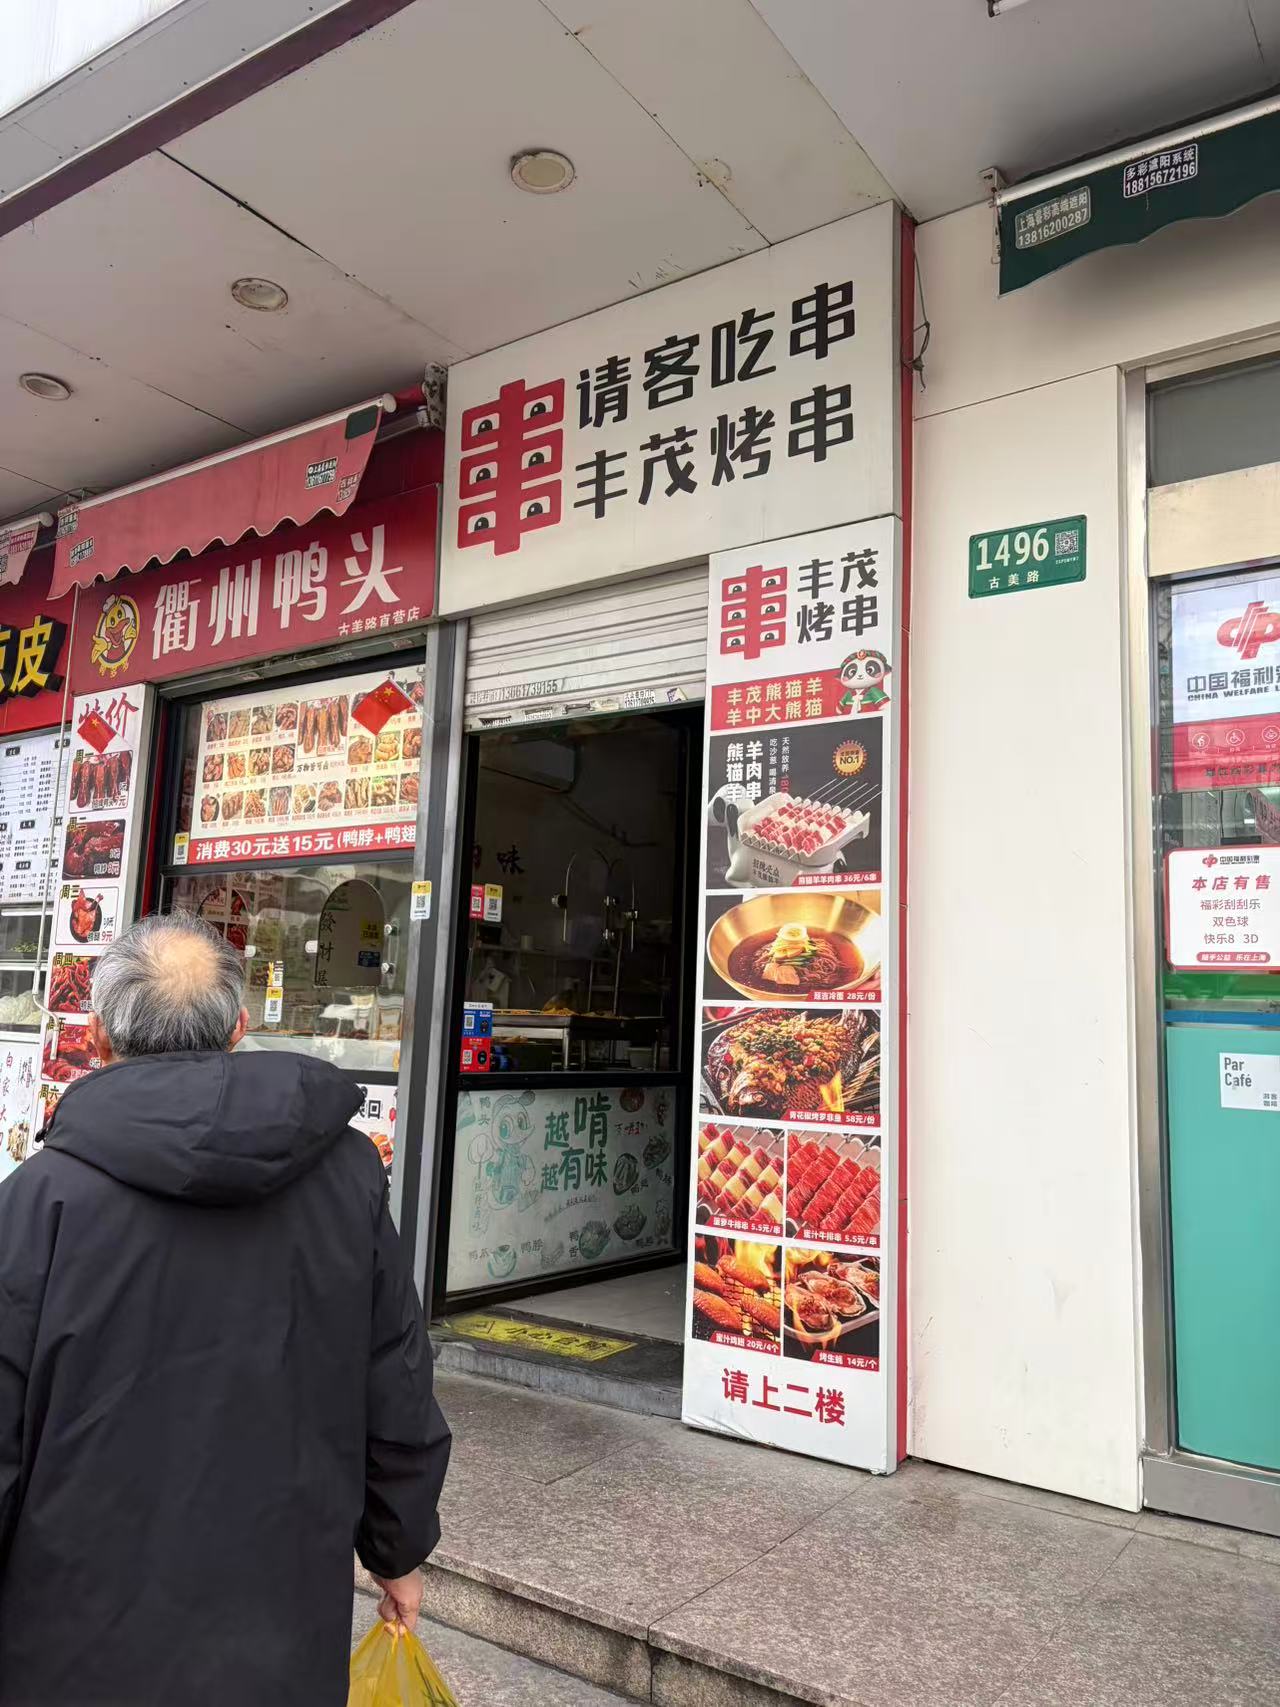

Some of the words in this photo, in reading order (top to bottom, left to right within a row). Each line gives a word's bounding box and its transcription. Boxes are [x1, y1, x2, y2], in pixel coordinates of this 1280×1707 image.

[1125, 162, 1196, 195] 18815672196
[1018, 208, 1088, 246] 13816200287
[575, 280, 856, 430] 请客吃串
[573, 384, 855, 519] 丰茂烤串
[976, 528, 1049, 571] 1496
[797, 548, 879, 599] 丰茂
[989, 570, 1039, 589] 古美路
[152, 524, 403, 660] 衢州鸭头
[796, 594, 878, 644] 烤串
[1187, 664, 1280, 694] 中国福利
[726, 677, 823, 706] 丰茂熊猫羊
[1187, 691, 1218, 702] CHINA
[1223, 686, 1270, 698] WELFARE
[725, 698, 822, 726] 羊中大熊猫
[726, 743, 744, 803] 熊猫羊
[746, 740, 763, 801] 羊肉串
[843, 873, 877, 882] 36元/6串
[1191, 875, 1271, 891] 本店有售
[1200, 898, 1261, 911] 福彩刮刮乐
[1212, 916, 1249, 927] 双色球
[1204, 933, 1235, 944] 快乐8
[1243, 934, 1259, 944] 3D
[847, 992, 876, 1001] 28元/份
[1224, 1057, 1244, 1071] Par
[1224, 1072, 1252, 1087] Café
[846, 1115, 875, 1124] 58元/份
[540, 1147, 608, 1193] 越有味
[751, 1223, 781, 1234] 5.5元/串
[844, 1234, 877, 1245] 5.5元/串
[746, 1338, 779, 1353] 20元/4个
[819, 1352, 843, 1365] 烤生蚝
[847, 1357, 877, 1369] 14元/个
[721, 1367, 845, 1427] 请上二楼
